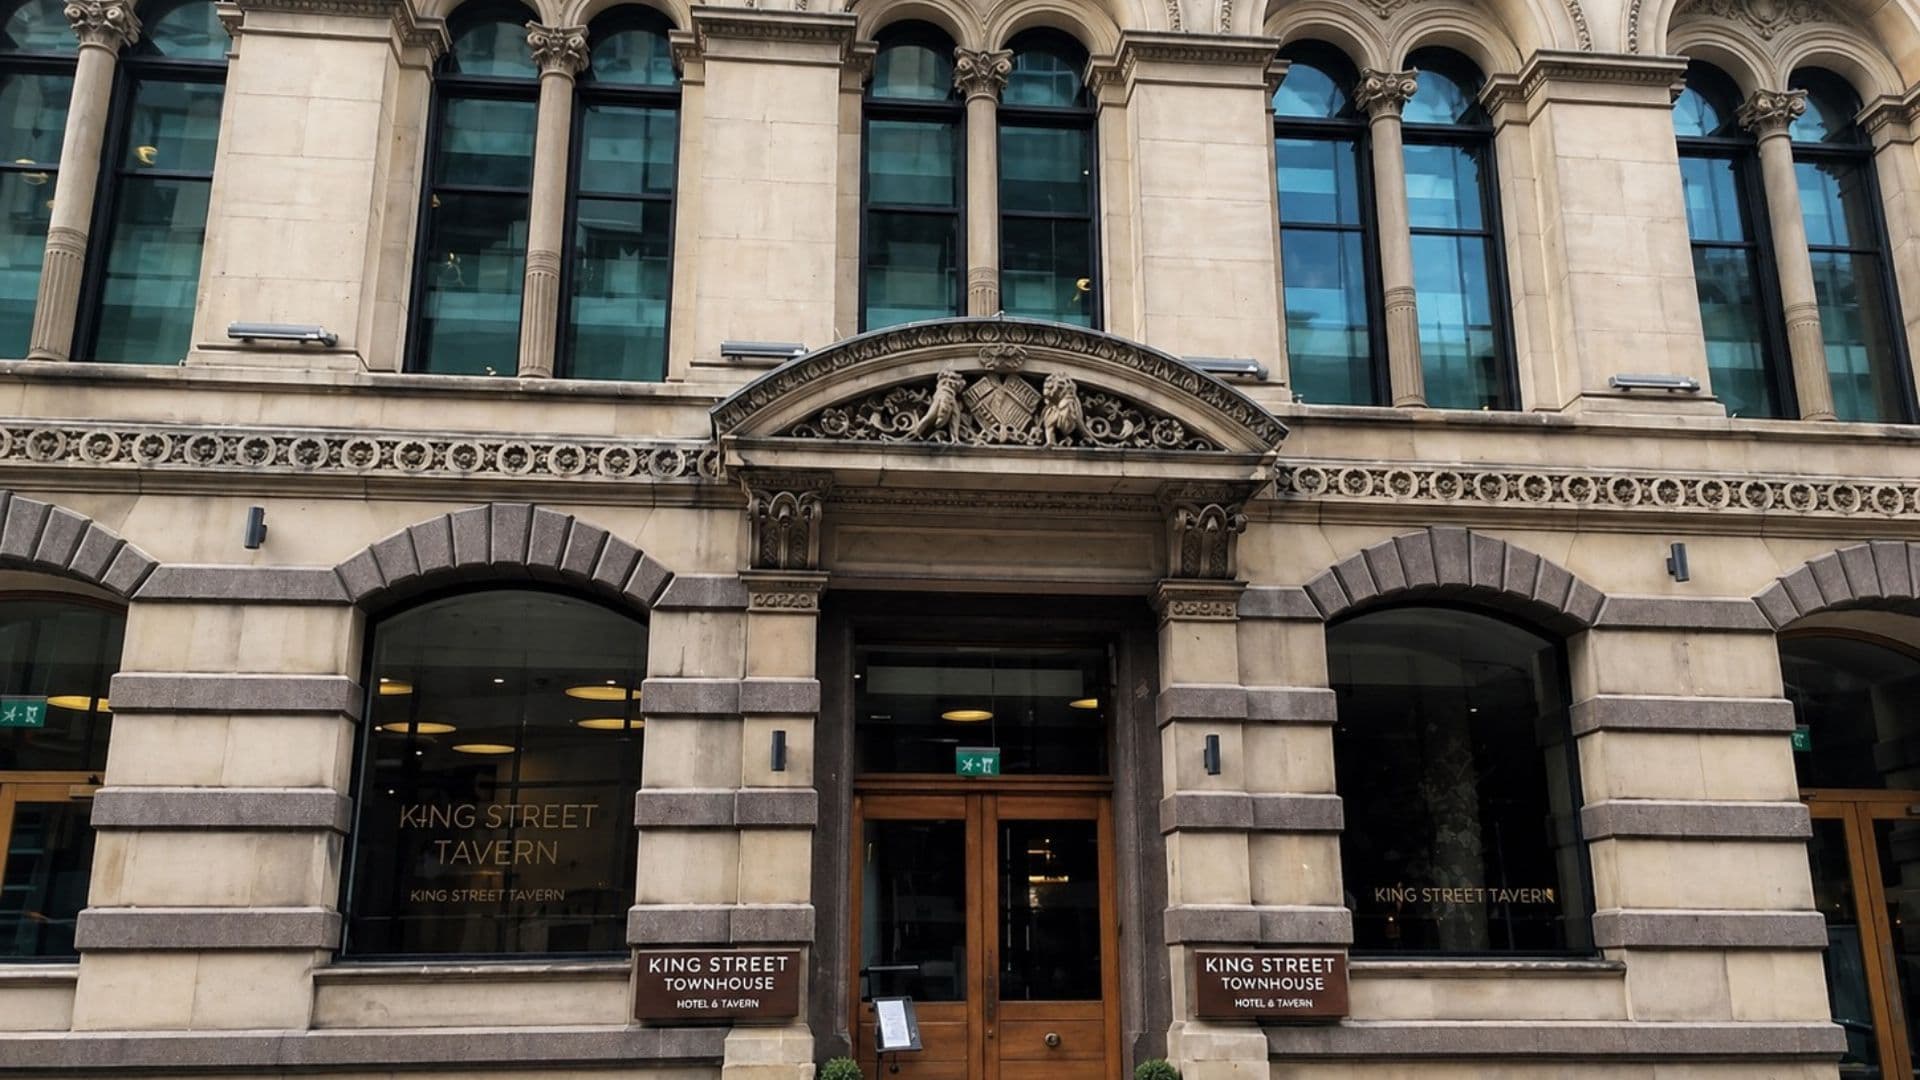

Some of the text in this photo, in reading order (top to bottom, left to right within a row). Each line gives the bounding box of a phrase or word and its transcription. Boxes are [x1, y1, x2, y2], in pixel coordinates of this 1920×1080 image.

[399, 803, 599, 829] KING STREET
[434, 839, 558, 866] TAVERN
[410, 888, 566, 902] KING STREET TAVERN
[1375, 887, 1556, 904] KING STREET TAVERN
[649, 956, 789, 974] KING STREET
[1205, 957, 1336, 974] KING STREET
[664, 976, 775, 992] TOWNHOUSE
[1221, 976, 1325, 991] TOWNHOUSE
[676, 999, 710, 1009] HOTEL
[721, 998, 760, 1008] TAVERN
[1234, 998, 1266, 1008] HOTEL
[1278, 998, 1313, 1008] TAVERN
